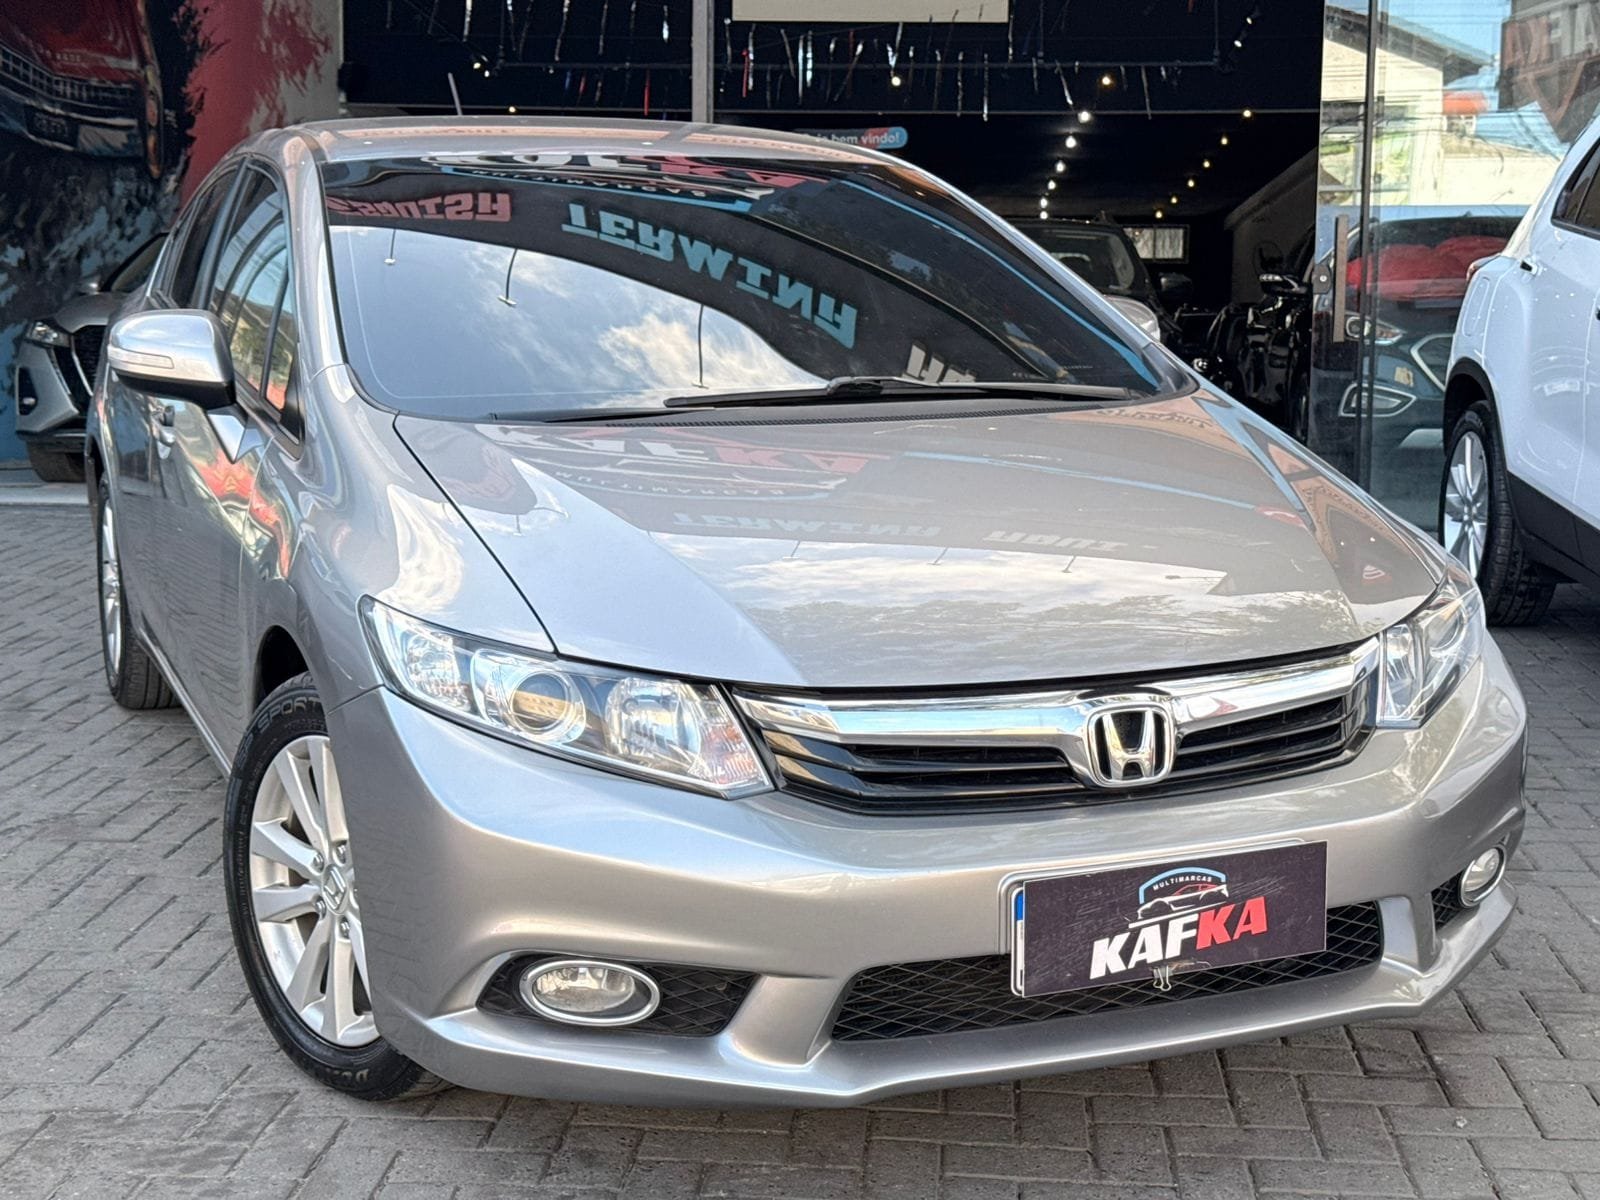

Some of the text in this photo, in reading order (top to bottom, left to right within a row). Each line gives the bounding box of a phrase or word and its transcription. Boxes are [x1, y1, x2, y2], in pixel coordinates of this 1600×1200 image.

[861, 132, 900, 145] vindo!
[1152, 875, 1213, 892] MULTIMARCAS
[1089, 896, 1268, 980] KAFKA
